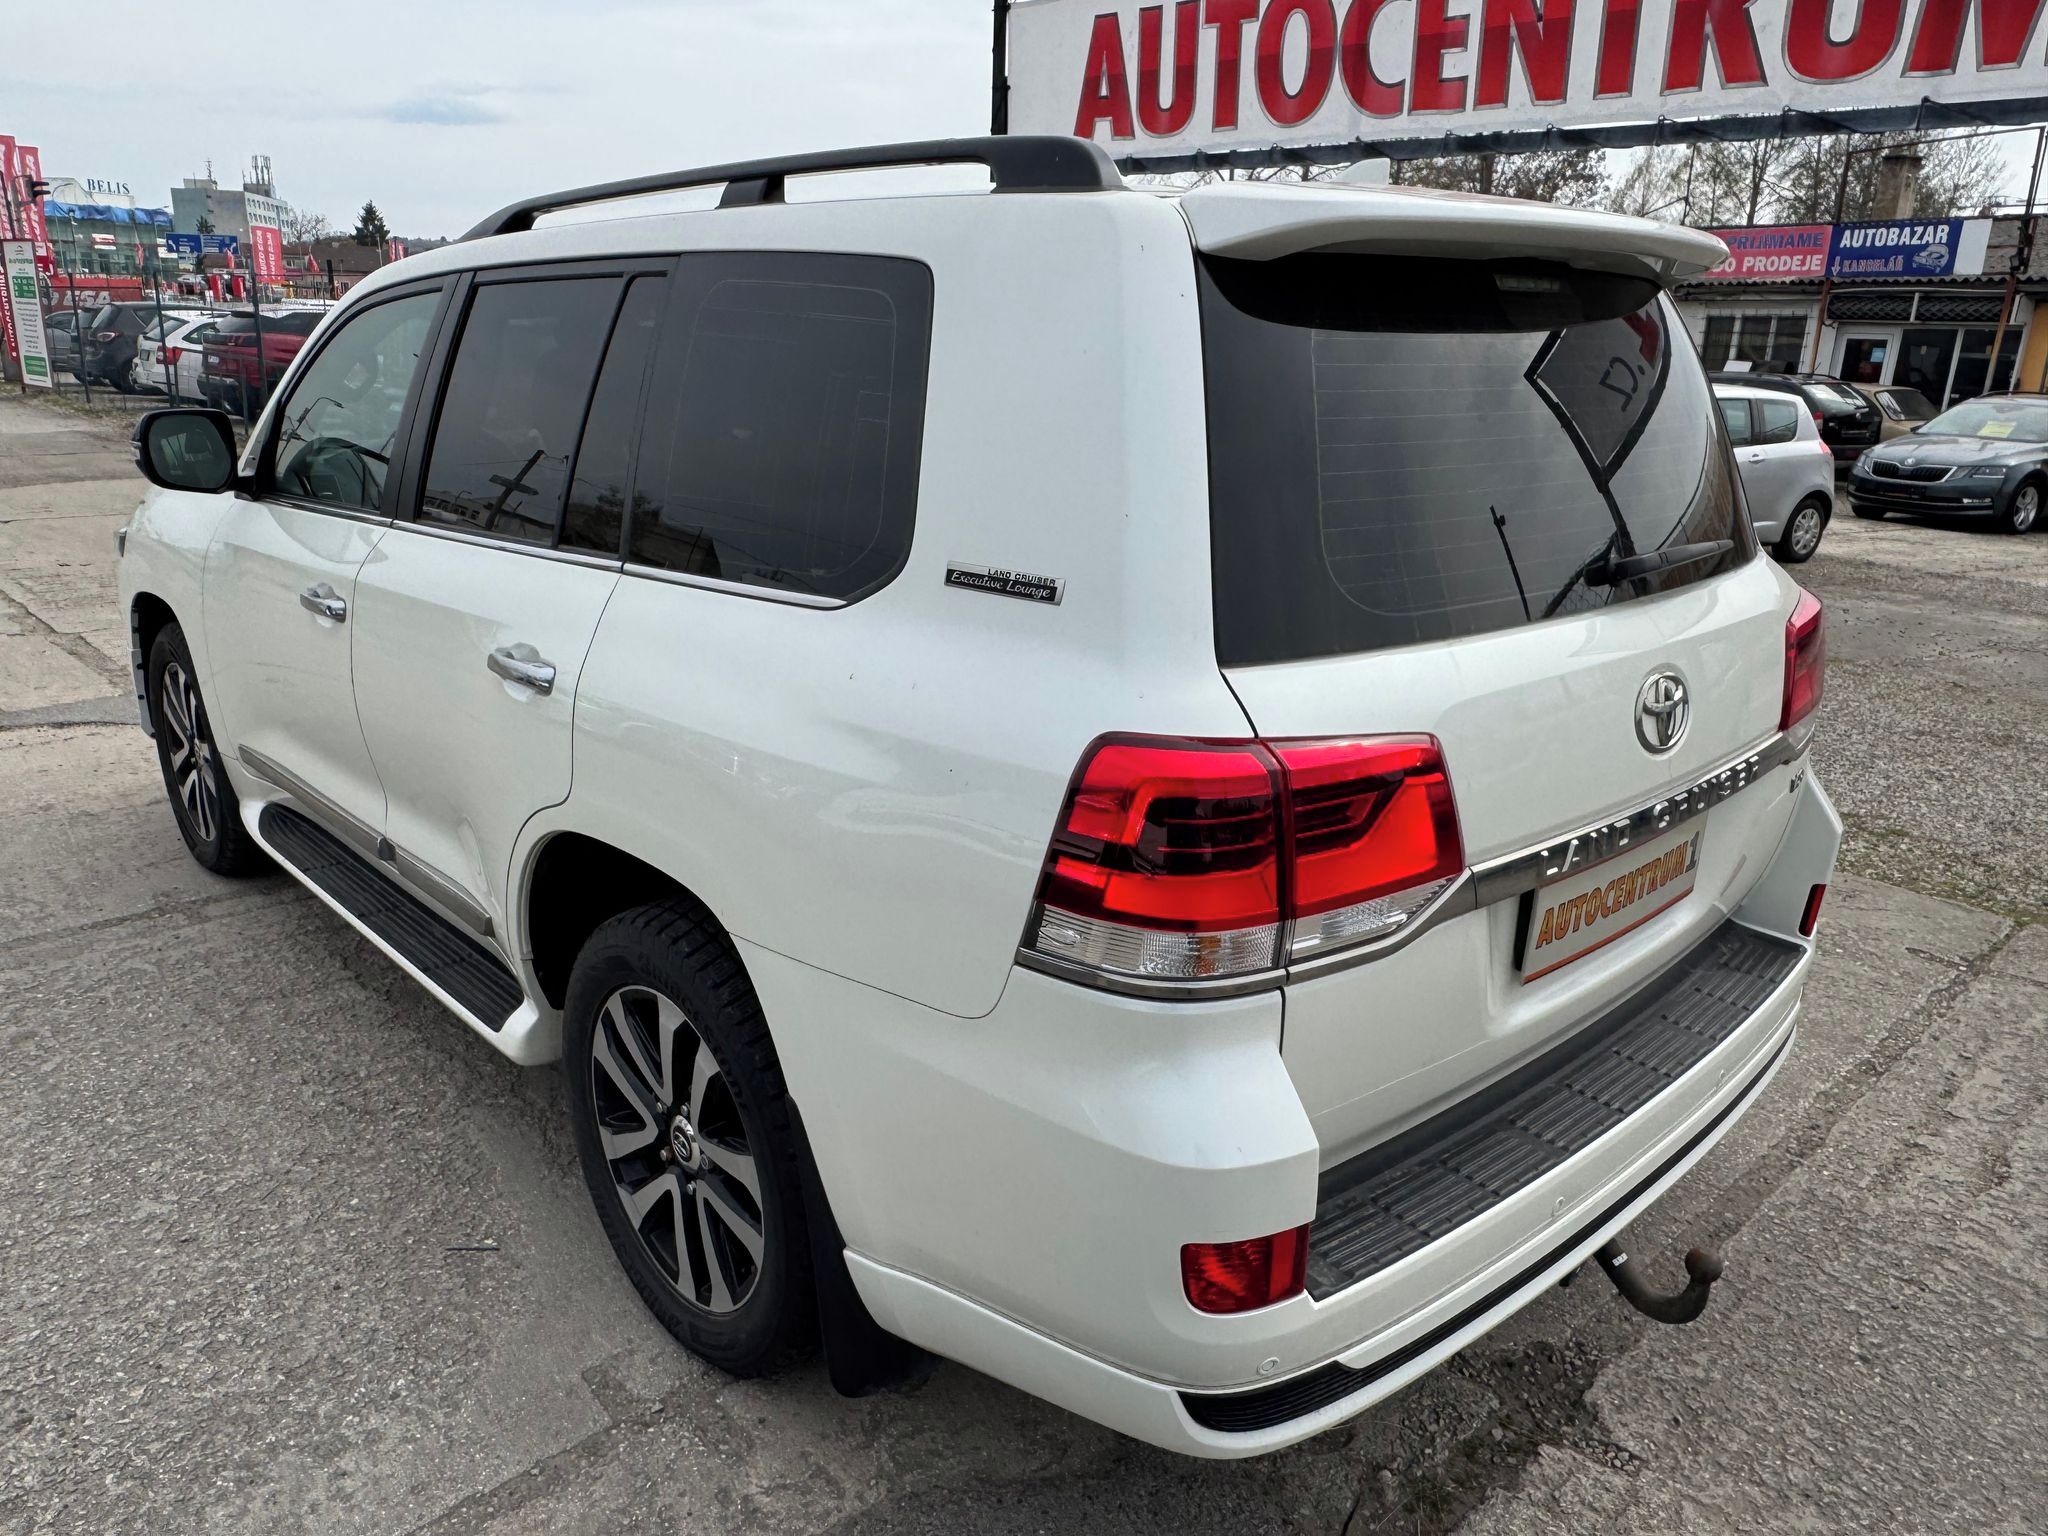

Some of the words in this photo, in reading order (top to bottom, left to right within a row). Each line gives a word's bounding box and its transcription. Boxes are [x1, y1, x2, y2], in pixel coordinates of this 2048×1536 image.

[87, 178, 130, 194] BELIS
[1840, 224, 1950, 249] AUTOBAZAR
[1742, 254, 1824, 273] PRODEJE
[987, 568, 1012, 579] LAND
[951, 571, 1004, 590] Executive
[1006, 580, 1051, 599] Lounge
